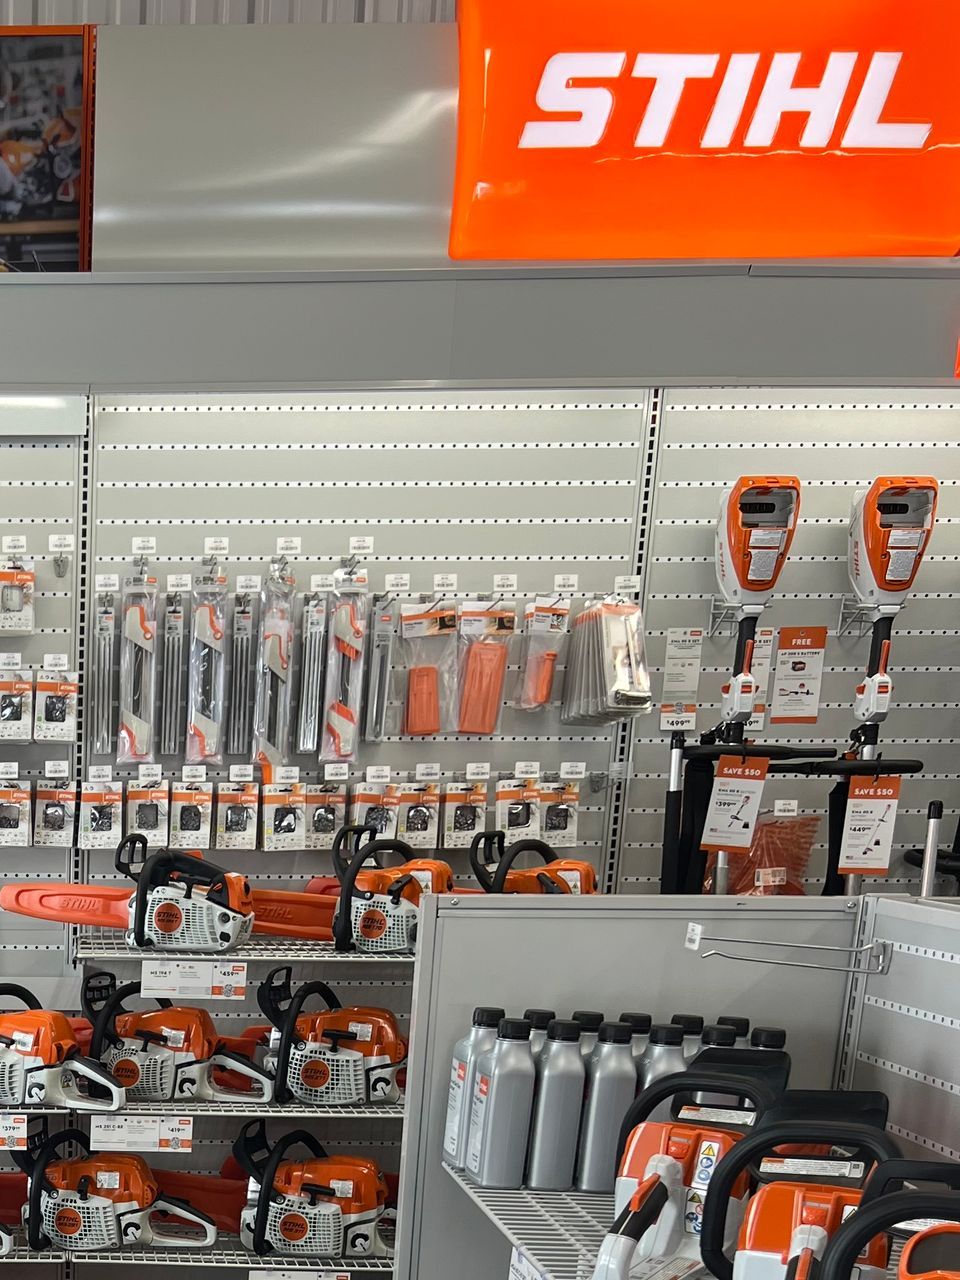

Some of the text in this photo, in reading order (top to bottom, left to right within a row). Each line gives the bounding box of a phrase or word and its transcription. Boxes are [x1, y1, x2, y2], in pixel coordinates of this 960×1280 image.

[518, 51, 933, 149] STIHL
[791, 638, 812, 646] FREE
[723, 767, 761, 776] SAVE $50
[854, 788, 894, 796] SAVE $50
[157, 911, 180, 919] STIHL
[362, 917, 384, 925] STIHL
[57, 1215, 79, 1223] STIHL
[282, 1220, 305, 1229] STIHL
